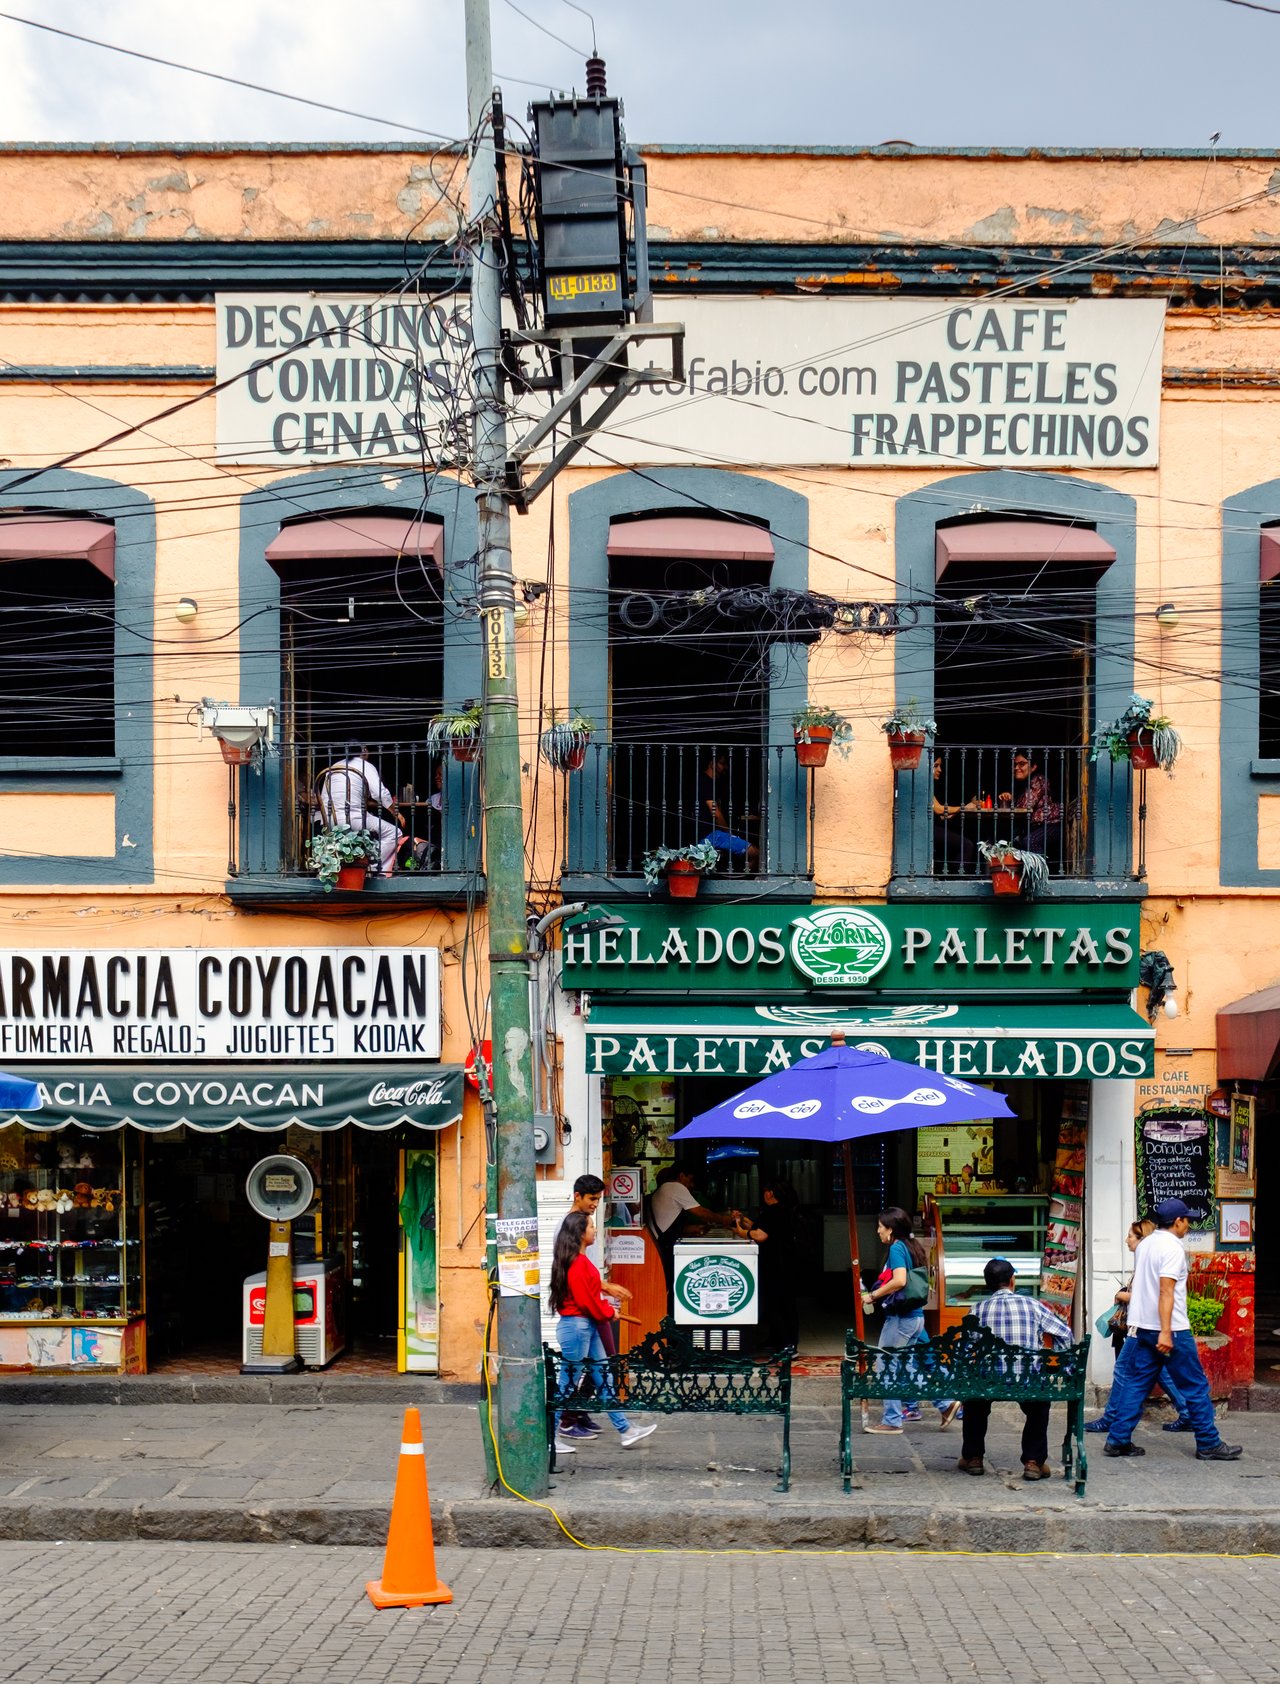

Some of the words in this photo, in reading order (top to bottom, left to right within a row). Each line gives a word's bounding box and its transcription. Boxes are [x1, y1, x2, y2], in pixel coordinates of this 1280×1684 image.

[552, 275, 614, 295] N1-0133
[225, 304, 473, 348] DESAYUNOS
[947, 308, 1067, 351] CAFE
[248, 358, 452, 403] COMIDAS
[894, 361, 1118, 405] PASTELES
[272, 412, 429, 457] CENAS
[852, 413, 1149, 459] FRAPPECHINOS
[563, 926, 786, 965] HELADOS
[804, 921, 882, 945] GLORIA
[901, 927, 1134, 965] PALETAS
[0, 956, 179, 1018] RMACIA
[199, 955, 427, 1018] COYOACAN
[816, 975, 845, 984] DESDE
[847, 975, 868, 984] 1950
[353, 1024, 426, 1053] KODAK
[915, 1040, 1148, 1077] HELADOS
[1163, 1071, 1189, 1082] CAFE
[133, 1082, 324, 1107] COYOACAN
[367, 1080, 445, 1108] Coca-Cola
[858, 1098, 883, 1111] ciel
[914, 1090, 938, 1103] ciel
[739, 1102, 764, 1115] ciel
[790, 1102, 816, 1115] ciel
[691, 1273, 743, 1289] GLORIA
